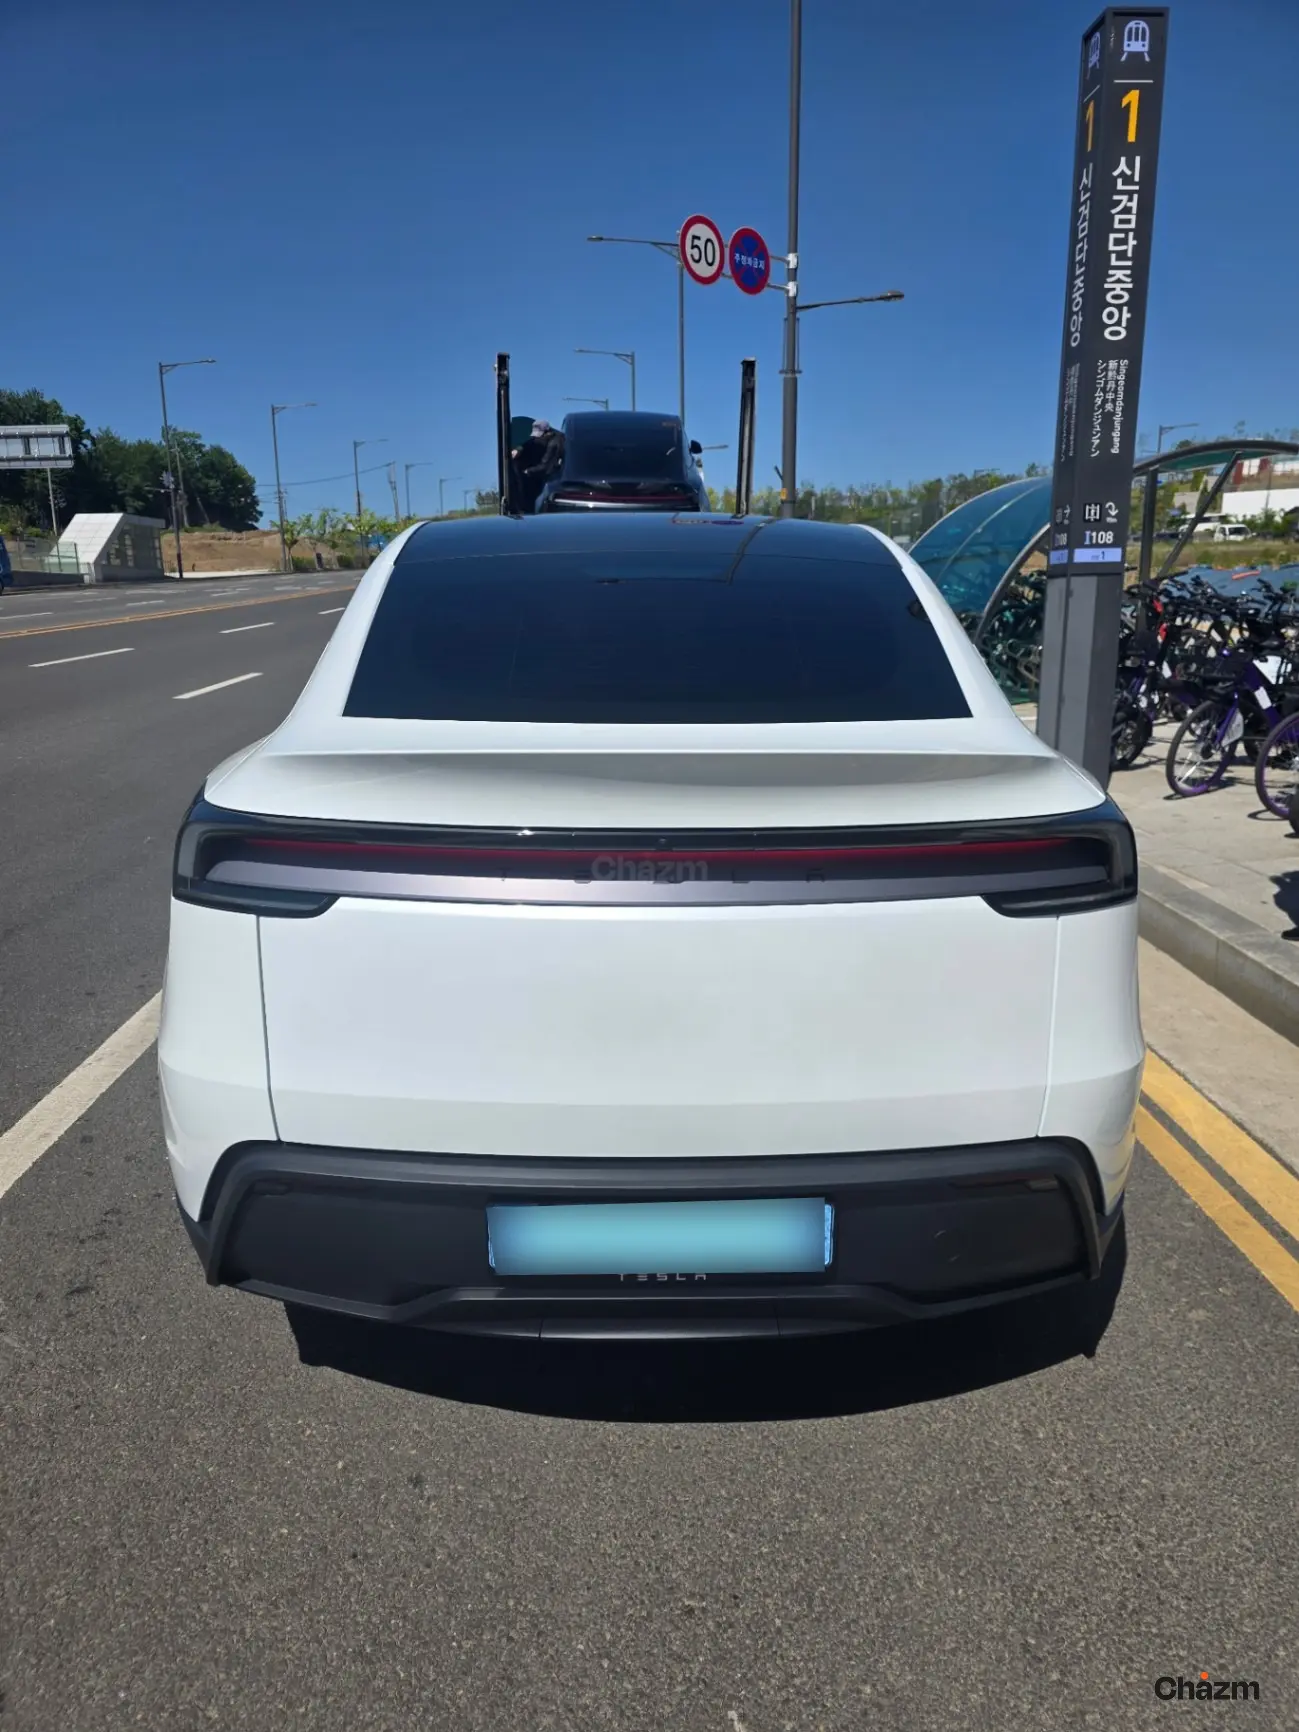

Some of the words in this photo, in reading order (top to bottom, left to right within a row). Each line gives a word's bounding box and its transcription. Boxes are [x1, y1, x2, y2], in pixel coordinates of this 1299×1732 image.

[1085, 100, 1095, 152] 1
[1121, 89, 1140, 143] 1
[690, 235, 715, 267] 50
[1070, 162, 1093, 347] 신검단중앙
[1102, 156, 1141, 341] 신검단중앙
[1110, 359, 1129, 454] Singeomdanjungang
